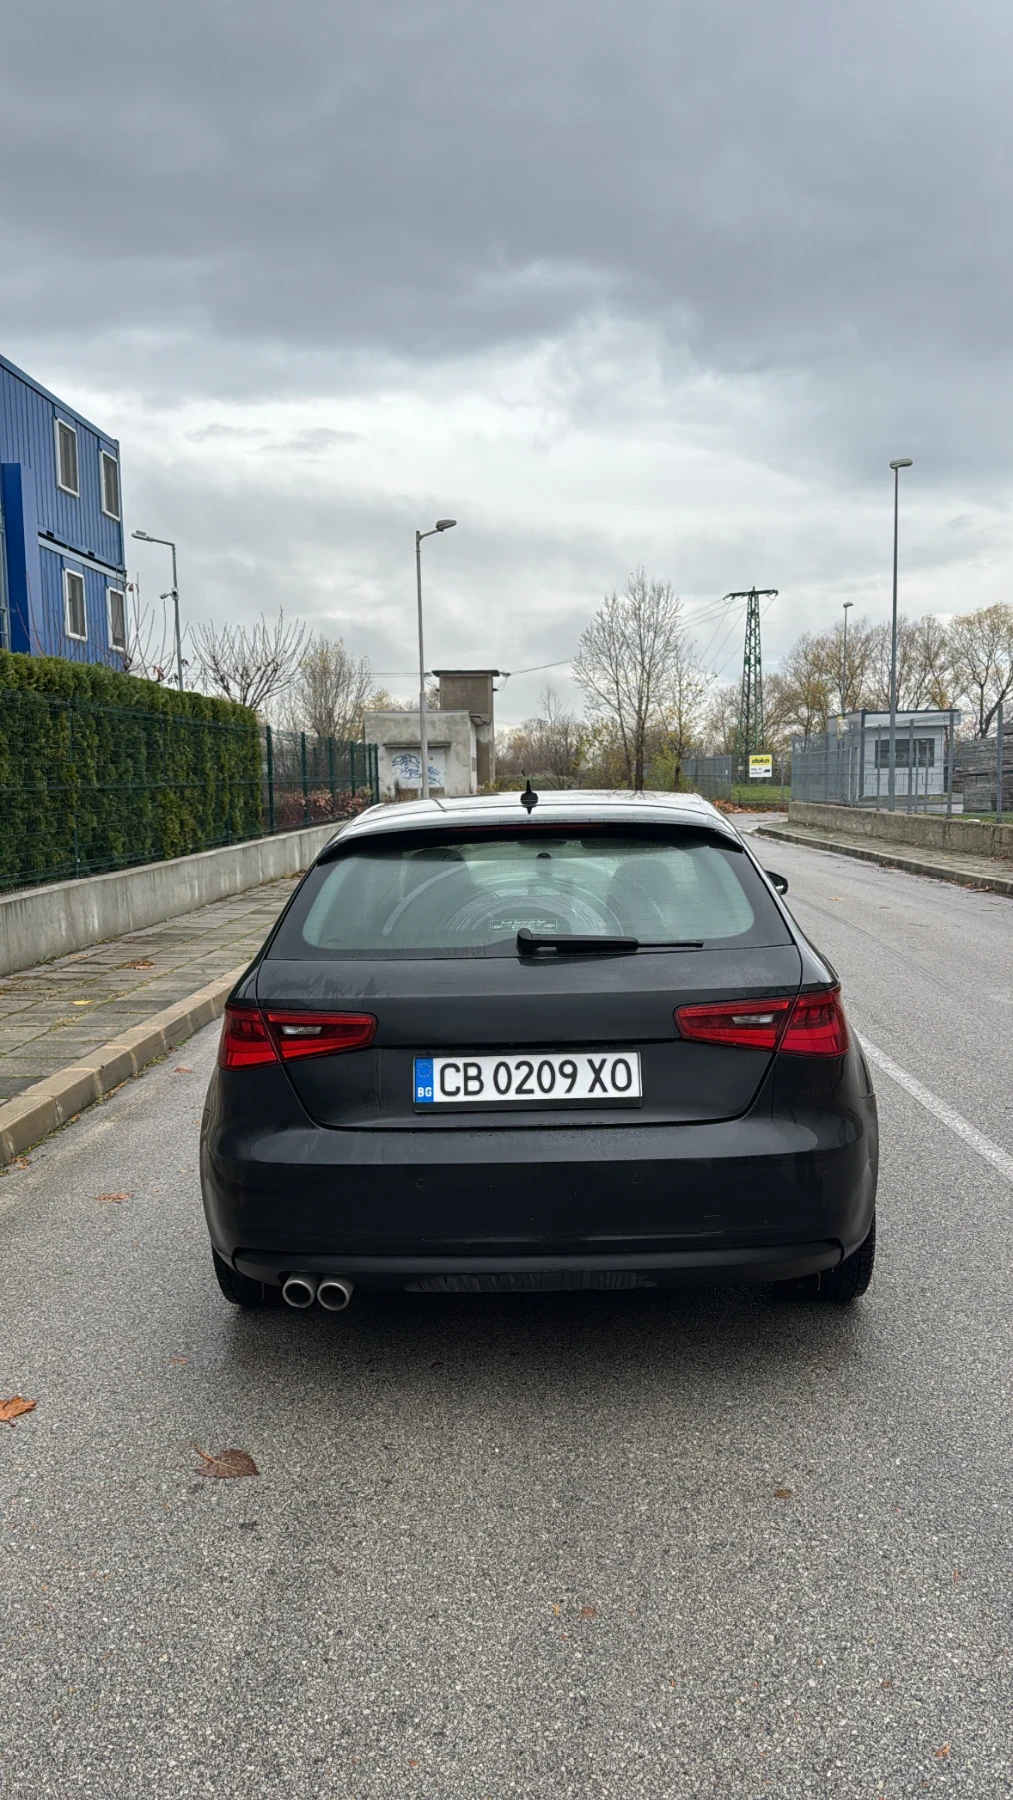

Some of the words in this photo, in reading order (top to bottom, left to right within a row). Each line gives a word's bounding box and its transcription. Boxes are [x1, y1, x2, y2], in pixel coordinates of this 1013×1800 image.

[440, 1062, 484, 1096] CB
[493, 1060, 578, 1095] 0209
[587, 1058, 633, 1093] XO
[417, 1086, 432, 1097] BG
